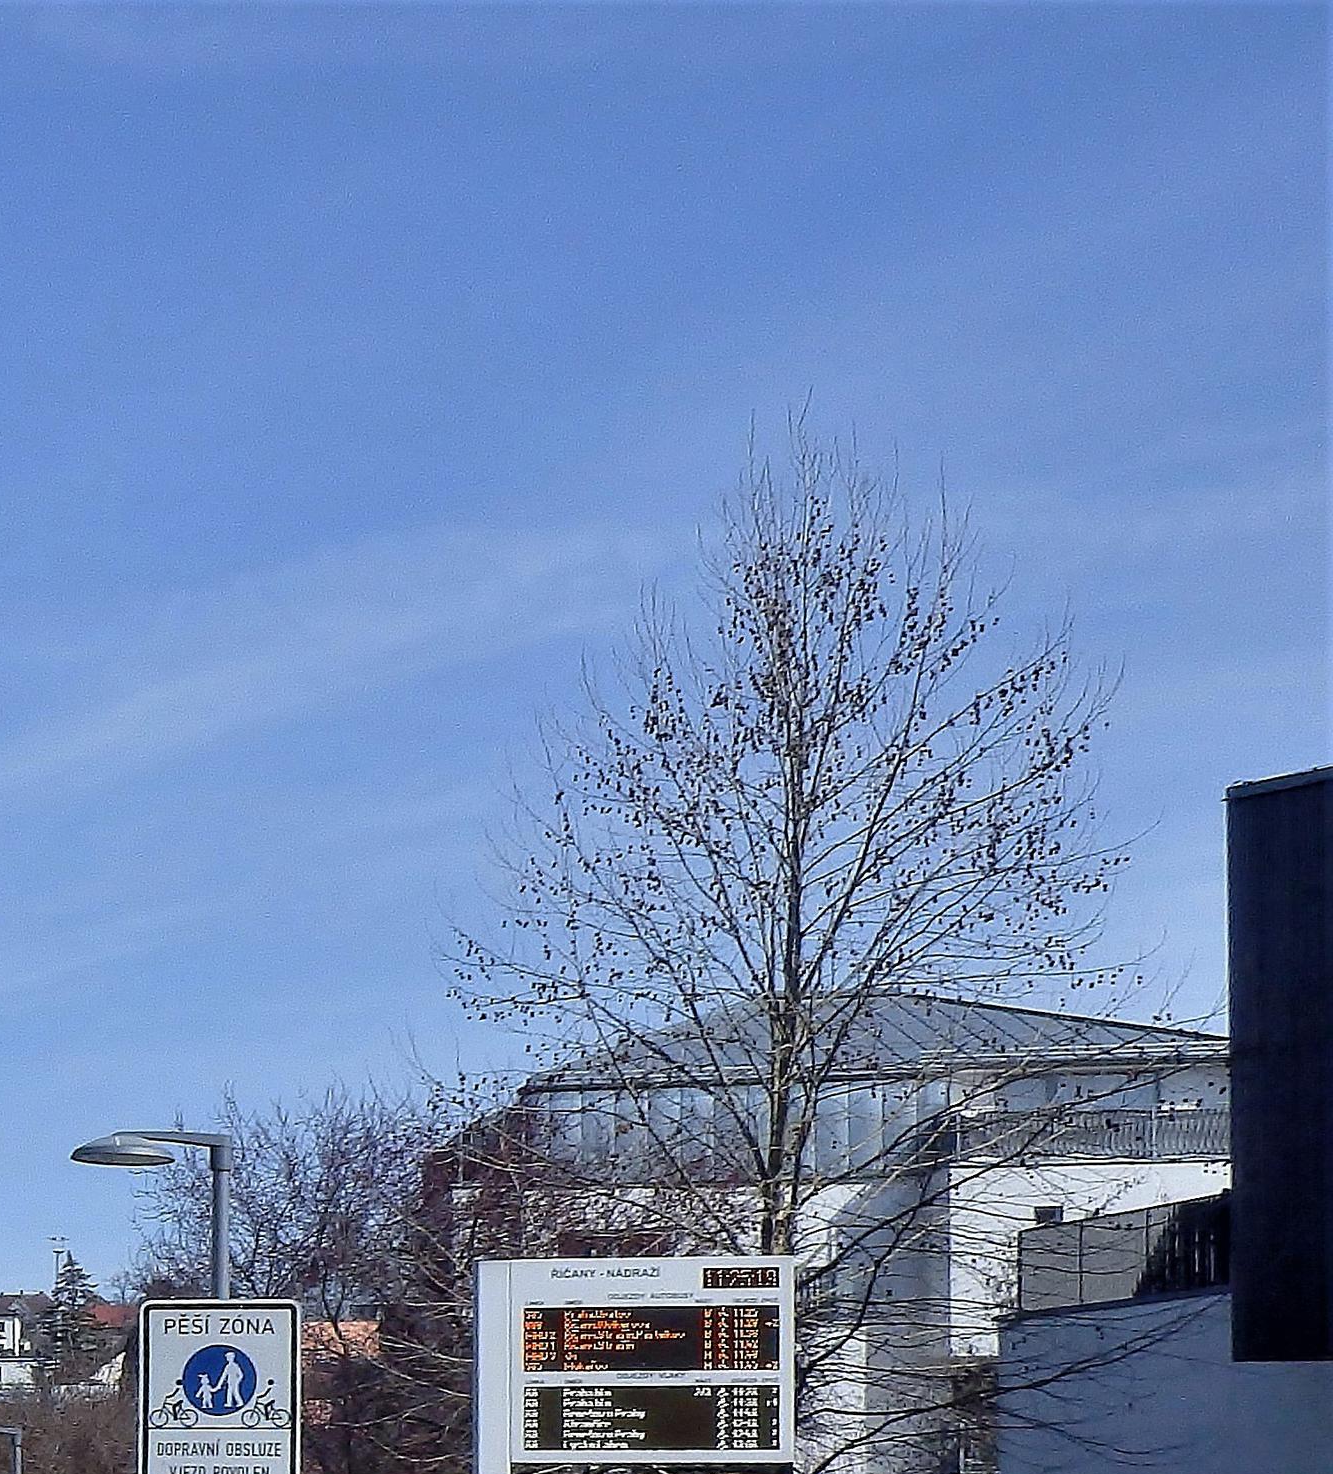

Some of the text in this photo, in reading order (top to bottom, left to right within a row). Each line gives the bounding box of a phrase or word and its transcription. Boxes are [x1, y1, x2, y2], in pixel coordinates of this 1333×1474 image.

[164, 1313, 275, 1335] PĚŠÍ ZÓNA
[157, 1439, 282, 1457] DOPRAVNÍ OBSLUZE
